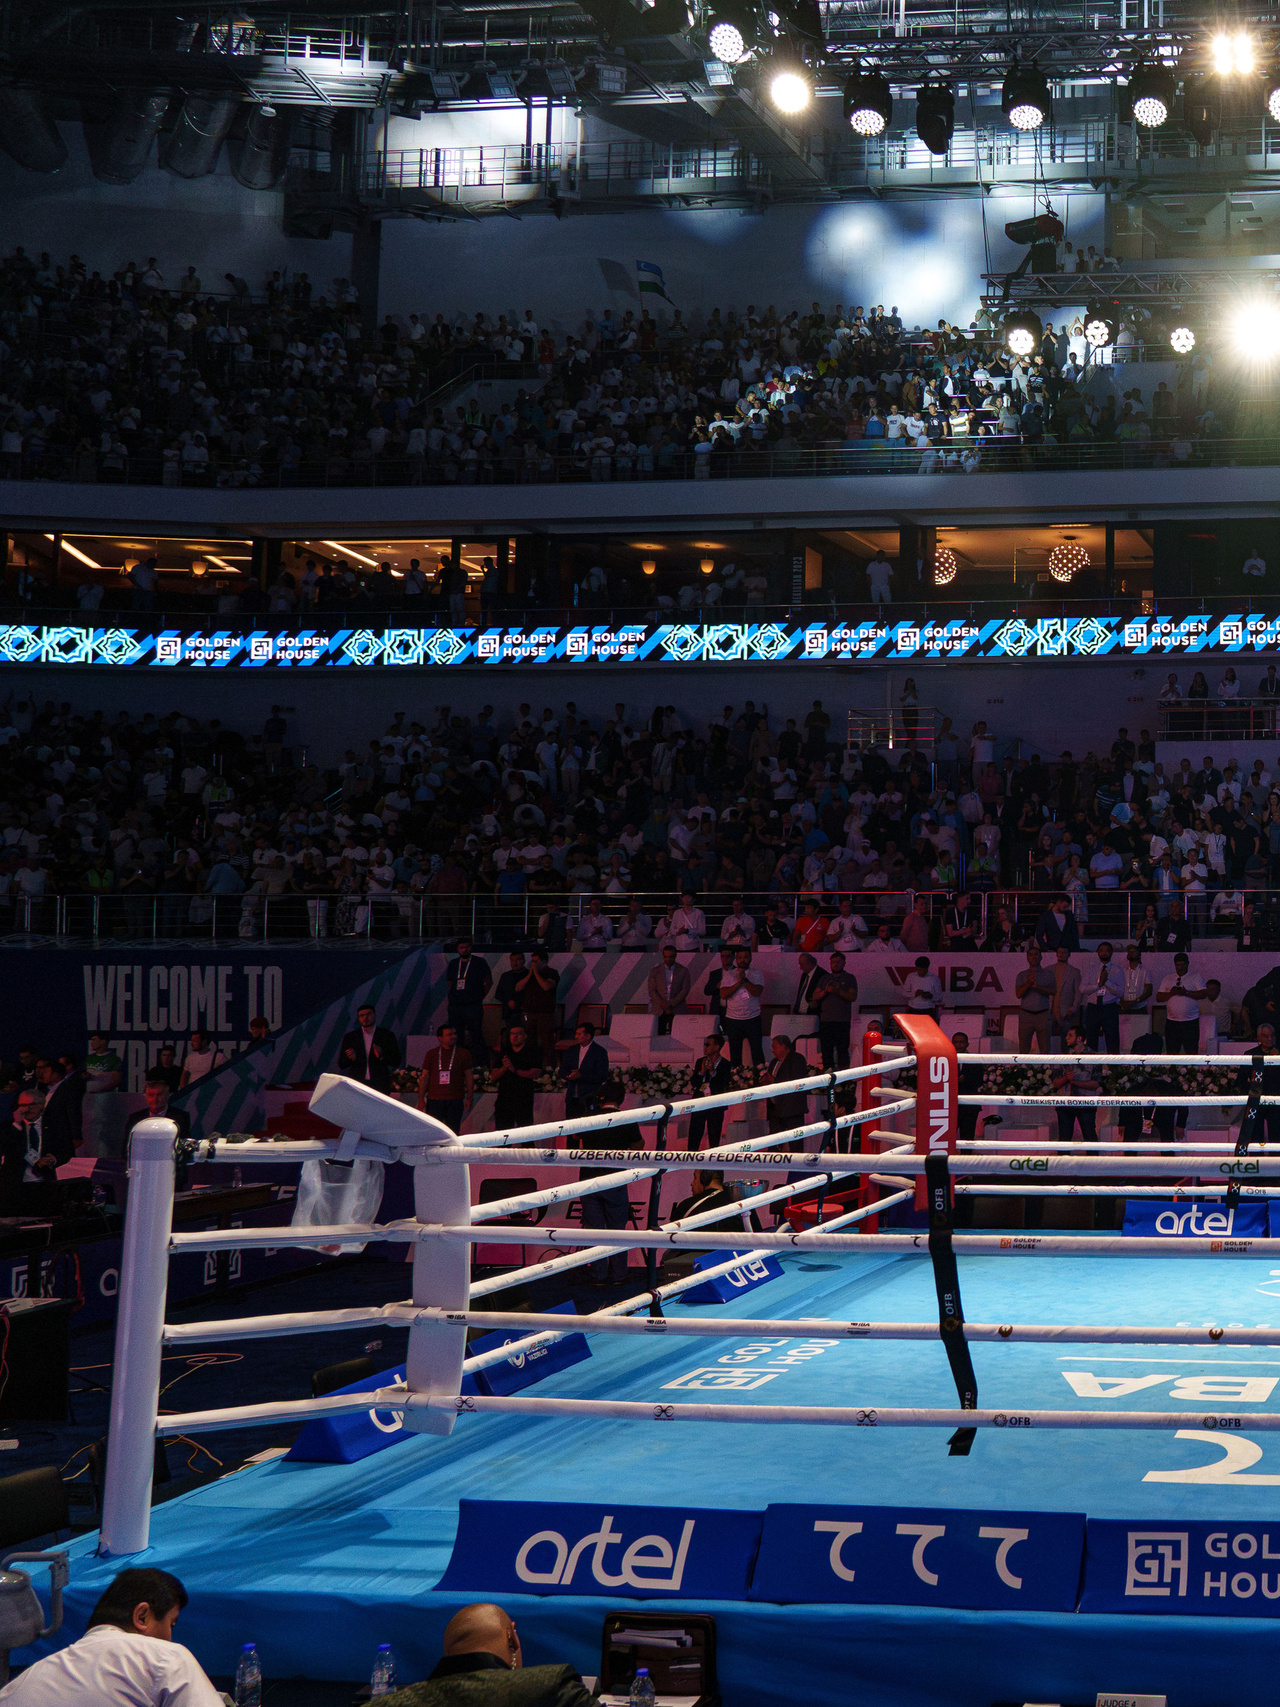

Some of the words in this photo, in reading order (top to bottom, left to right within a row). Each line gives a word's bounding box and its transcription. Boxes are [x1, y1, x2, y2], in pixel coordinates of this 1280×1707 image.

[924, 628, 978, 638] GOLDEN
[1152, 623, 1207, 633] GOLDEN
[504, 634, 555, 644] GOLDEN
[592, 633, 645, 643] GOLDEN
[832, 629, 885, 639] GOLDEN
[186, 638, 240, 648] GOLDEN
[277, 638, 328, 647] GOLDEN
[924, 641, 969, 651] HOUSE
[1152, 636, 1197, 647] HOUSE
[504, 647, 546, 657] HOUSE
[592, 646, 635, 655] HOUSE
[832, 642, 876, 652] HOUSE
[184, 651, 230, 660] HOUSE
[276, 650, 319, 660] HOUSE
[938, 967, 1004, 992] IBA
[83, 965, 233, 1031] WELCOME
[243, 965, 283, 1031] TO
[929, 1057, 949, 1155] STIN
[569, 1151, 651, 1161] UZBEKISTAN
[654, 1152, 705, 1162] BOXING
[708, 1153, 793, 1163] FEDERATION
[1009, 1157, 1049, 1171] artel
[1219, 1159, 1260, 1174] artel
[934, 1188, 943, 1211] OFB
[1155, 1204, 1235, 1236] artel
[945, 1293, 954, 1315] OFB
[767, 1340, 841, 1365] HOU
[1009, 1416, 1031, 1425] OFB
[1219, 1418, 1241, 1427] OFB
[515, 1516, 695, 1590] artel
[1101, 1699, 1129, 1707] JUDGE
